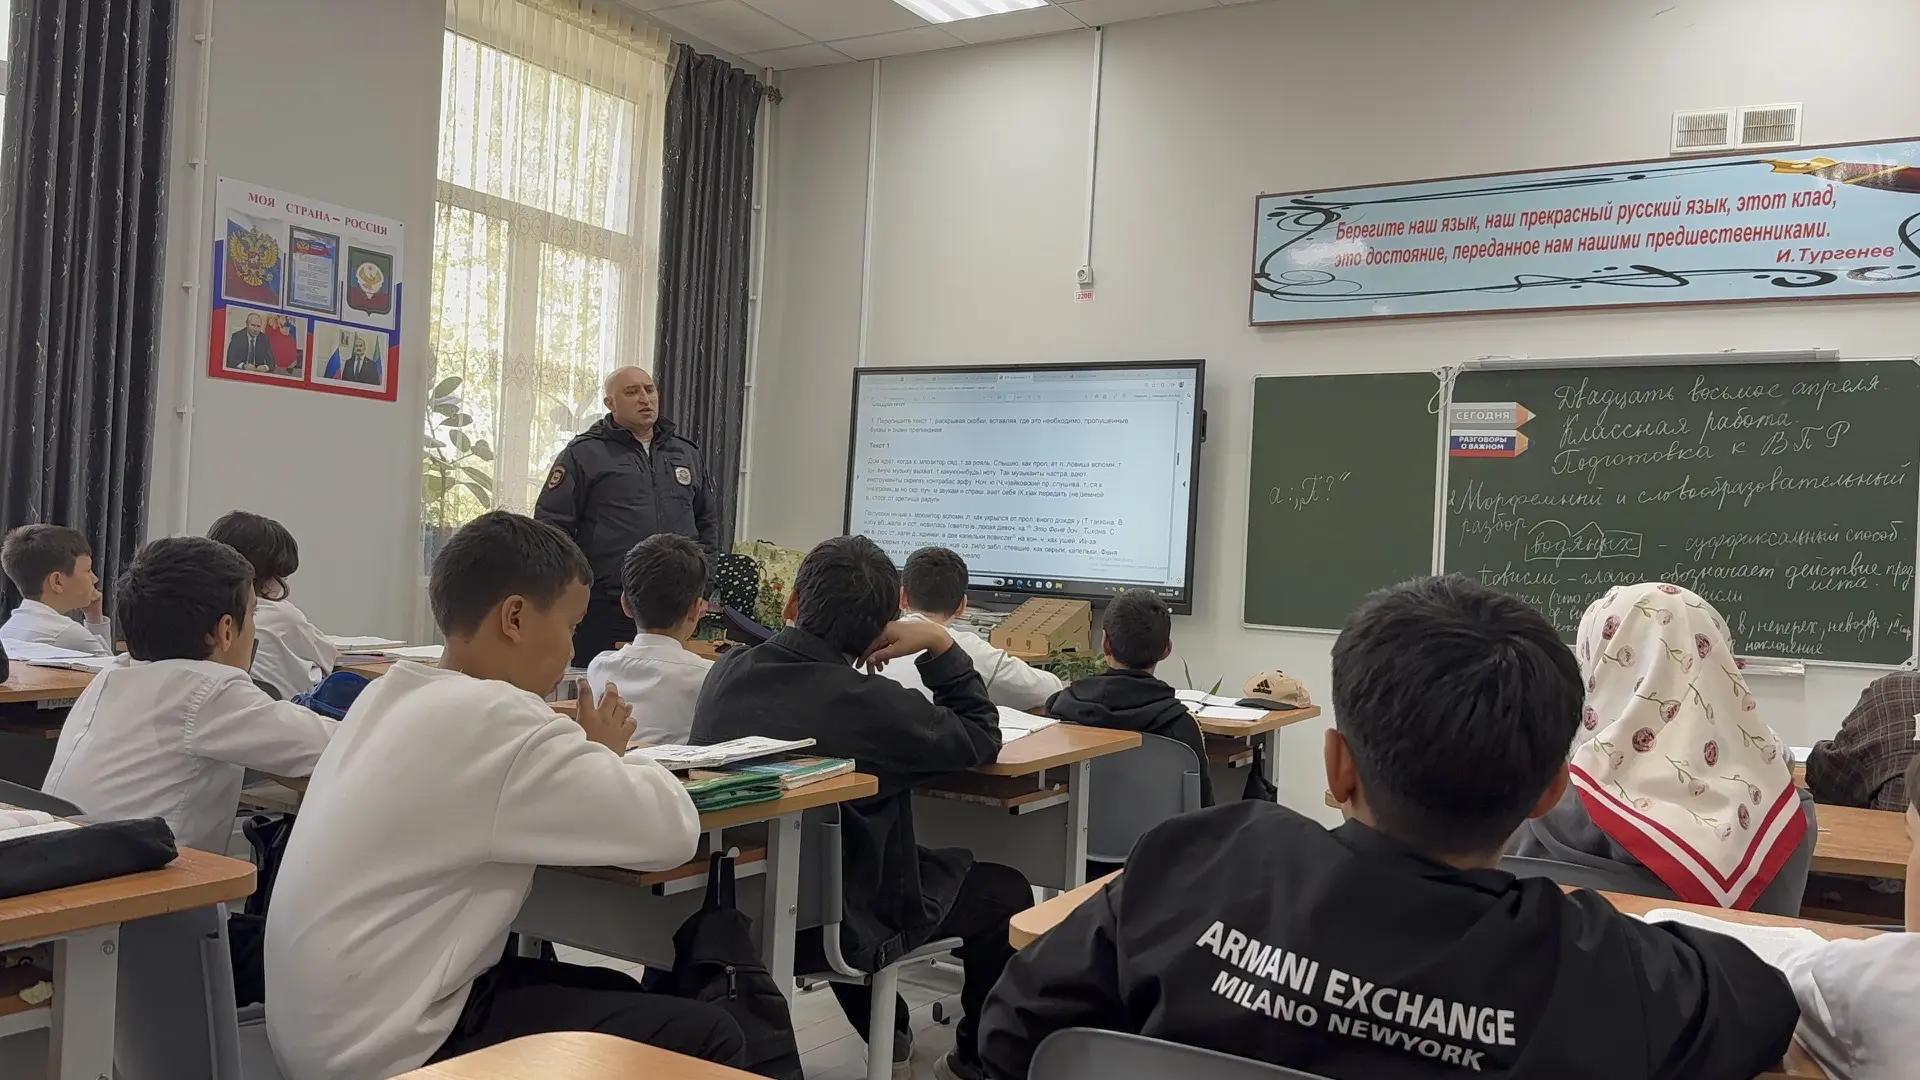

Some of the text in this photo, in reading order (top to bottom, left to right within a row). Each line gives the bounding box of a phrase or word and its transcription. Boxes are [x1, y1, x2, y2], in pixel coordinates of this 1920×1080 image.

[248, 192, 275, 208] МОЯ
[286, 202, 330, 222] СТРАНА
[344, 216, 388, 236] РОССИЯ
[1336, 184, 1837, 243] Берегите наш язык, наш прекрасный русский язык, этот клад,
[1334, 220, 1831, 268] это достояние, переданное нам нашими предшественниками.
[1456, 411, 1510, 420] СЕГОДНЯ
[1554, 376, 1675, 425] Двадцать
[1688, 374, 1782, 403] восьмое
[934, 418, 966, 426] раскрывая
[1560, 412, 1691, 449] Классная
[1551, 440, 1716, 484] Подготовка
[1732, 441, 1748, 454] к
[1453, 479, 1604, 523] Морфемный
[1616, 493, 1626, 505] и
[1637, 461, 1911, 511] словообразовательный
[1459, 513, 1528, 547] разбор
[1685, 523, 1839, 561] суффиксальный
[1660, 562, 1775, 592] обозначает
[1785, 550, 1882, 590] действие
[1196, 920, 1516, 1046] ARMANI EXCHANGE
[1211, 970, 1485, 1072] MILANO NEWYORK
